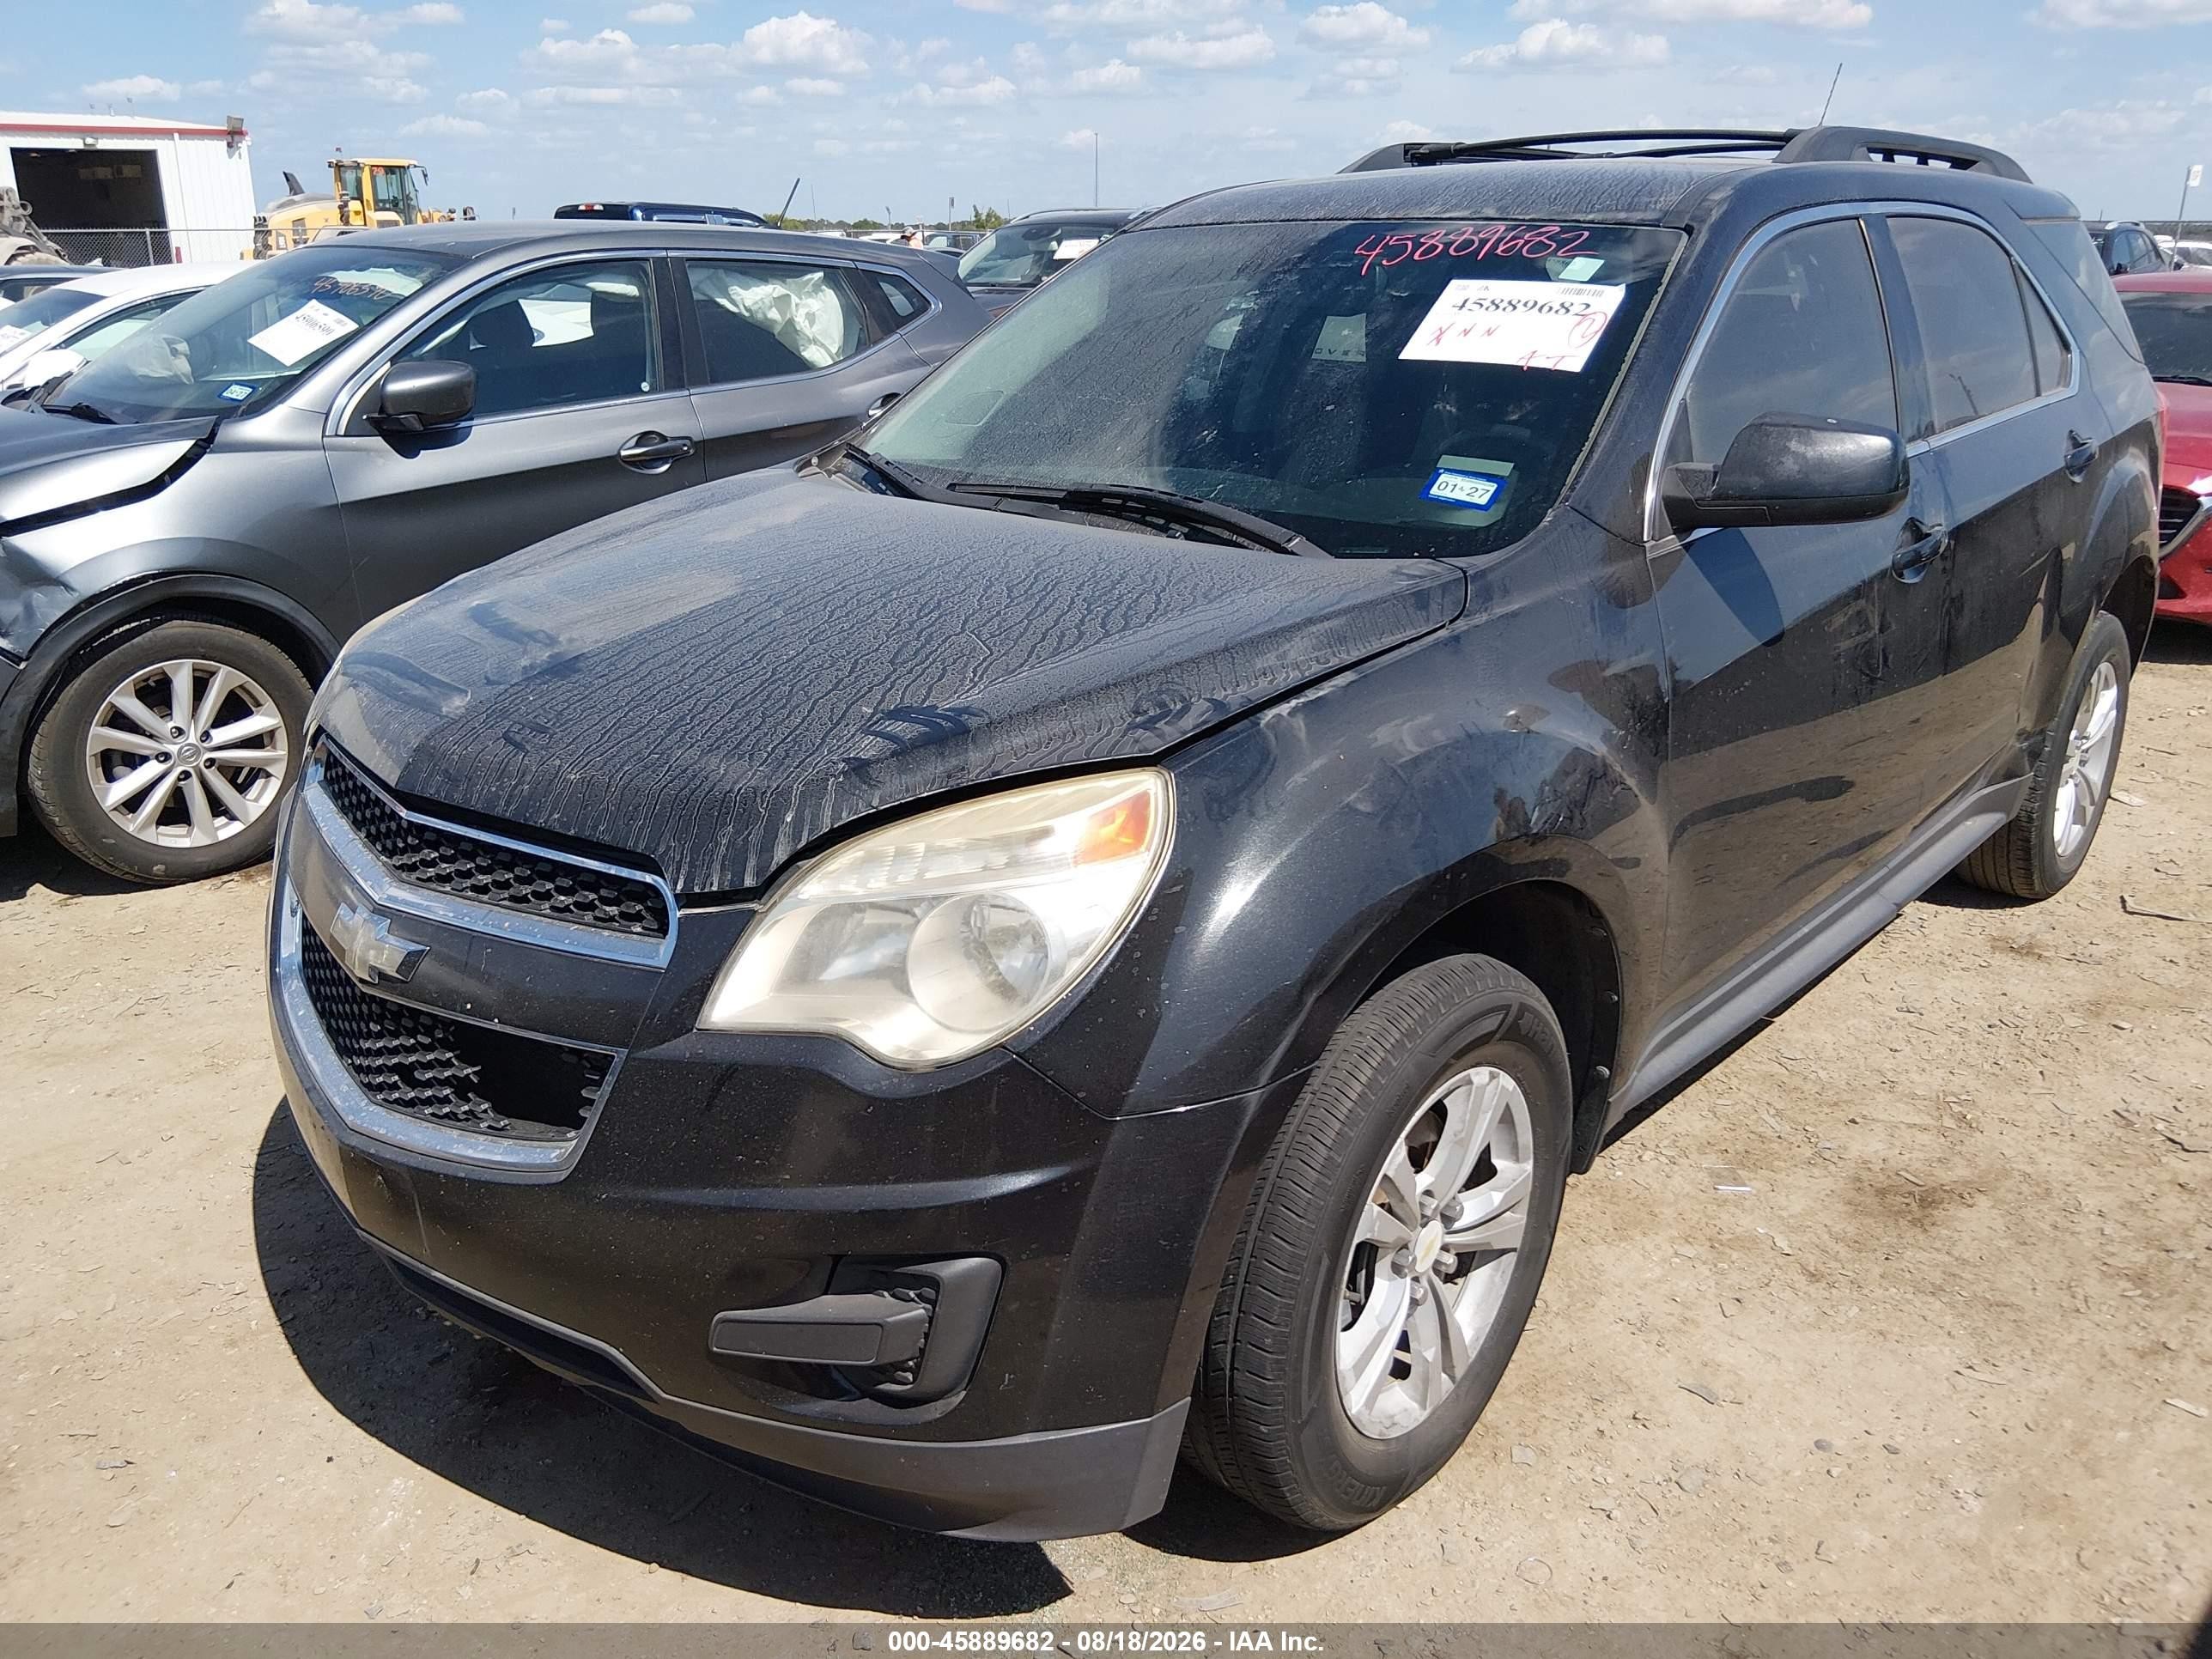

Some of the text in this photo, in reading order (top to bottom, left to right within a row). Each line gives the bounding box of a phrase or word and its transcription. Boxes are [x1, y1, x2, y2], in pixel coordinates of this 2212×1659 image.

[1354, 225, 1599, 276] 45889682
[1451, 296, 1591, 317] 45889682
[1437, 480, 1458, 493] 01
[1466, 486, 1491, 499] 27
